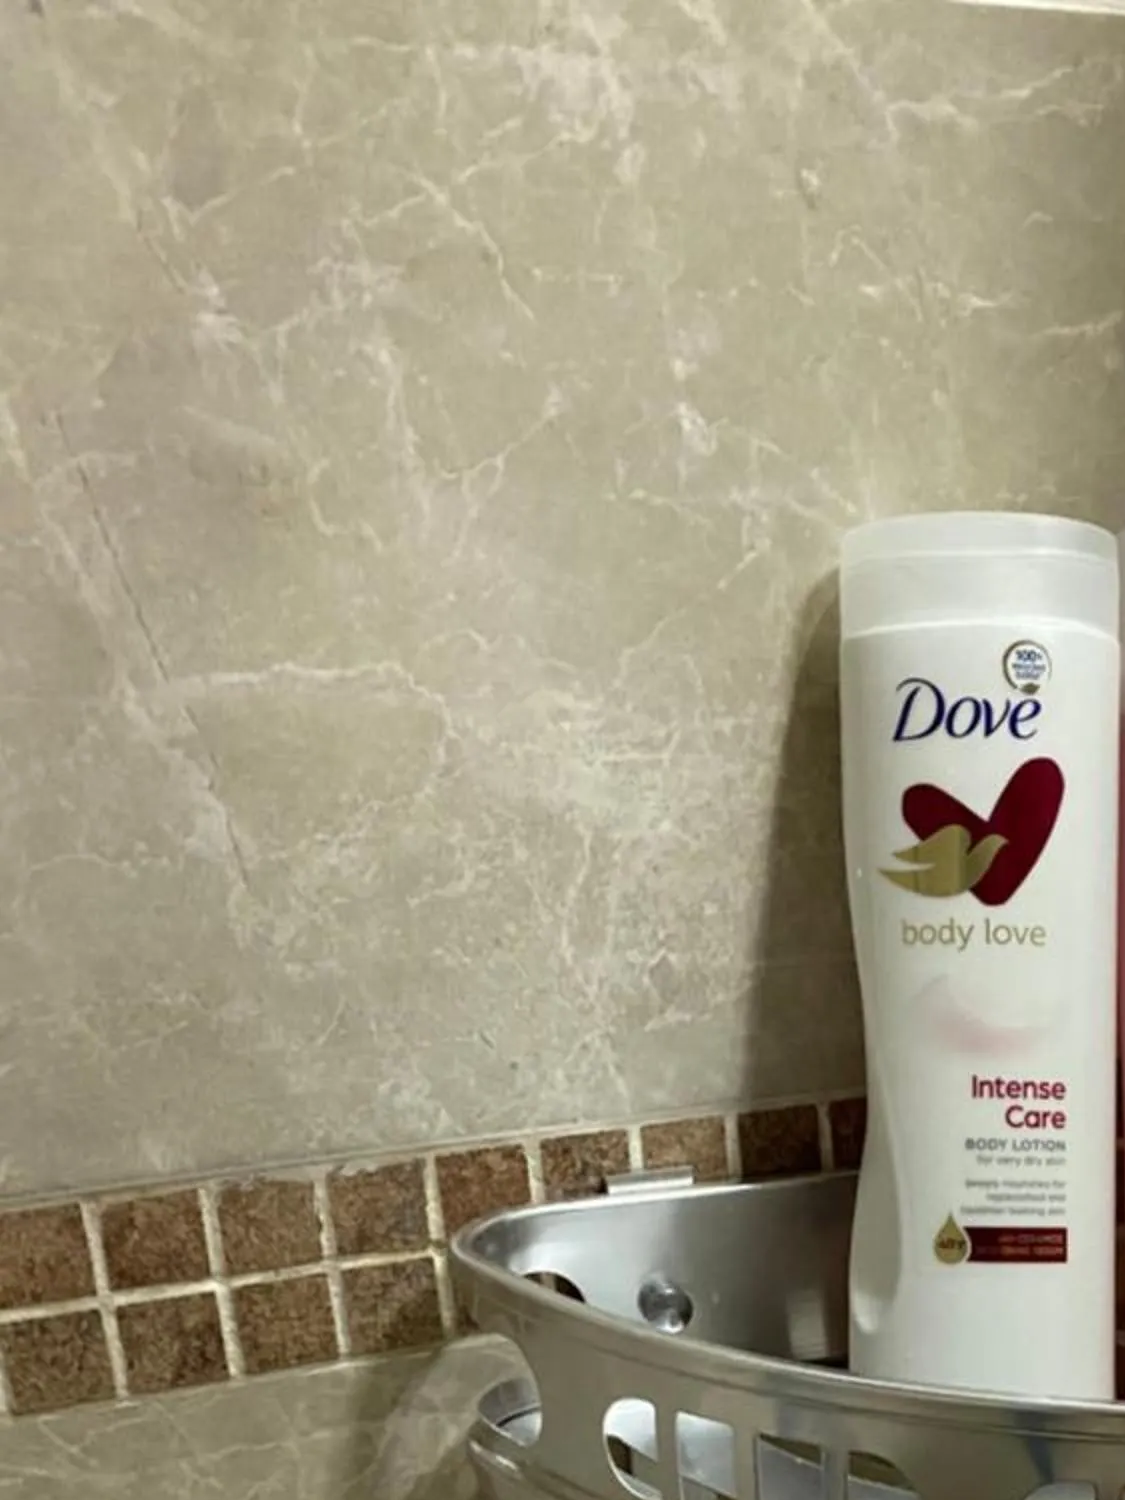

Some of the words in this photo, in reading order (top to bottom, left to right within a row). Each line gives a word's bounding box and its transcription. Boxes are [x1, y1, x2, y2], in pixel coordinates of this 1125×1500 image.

[893, 677, 1042, 741] Dove
[901, 918, 975, 952] body
[985, 918, 1047, 946] love
[971, 1074, 1067, 1100] Intense
[1004, 1104, 1067, 1129] Care
[965, 1138, 1008, 1151] BODY
[1012, 1139, 1067, 1151] LOTION
